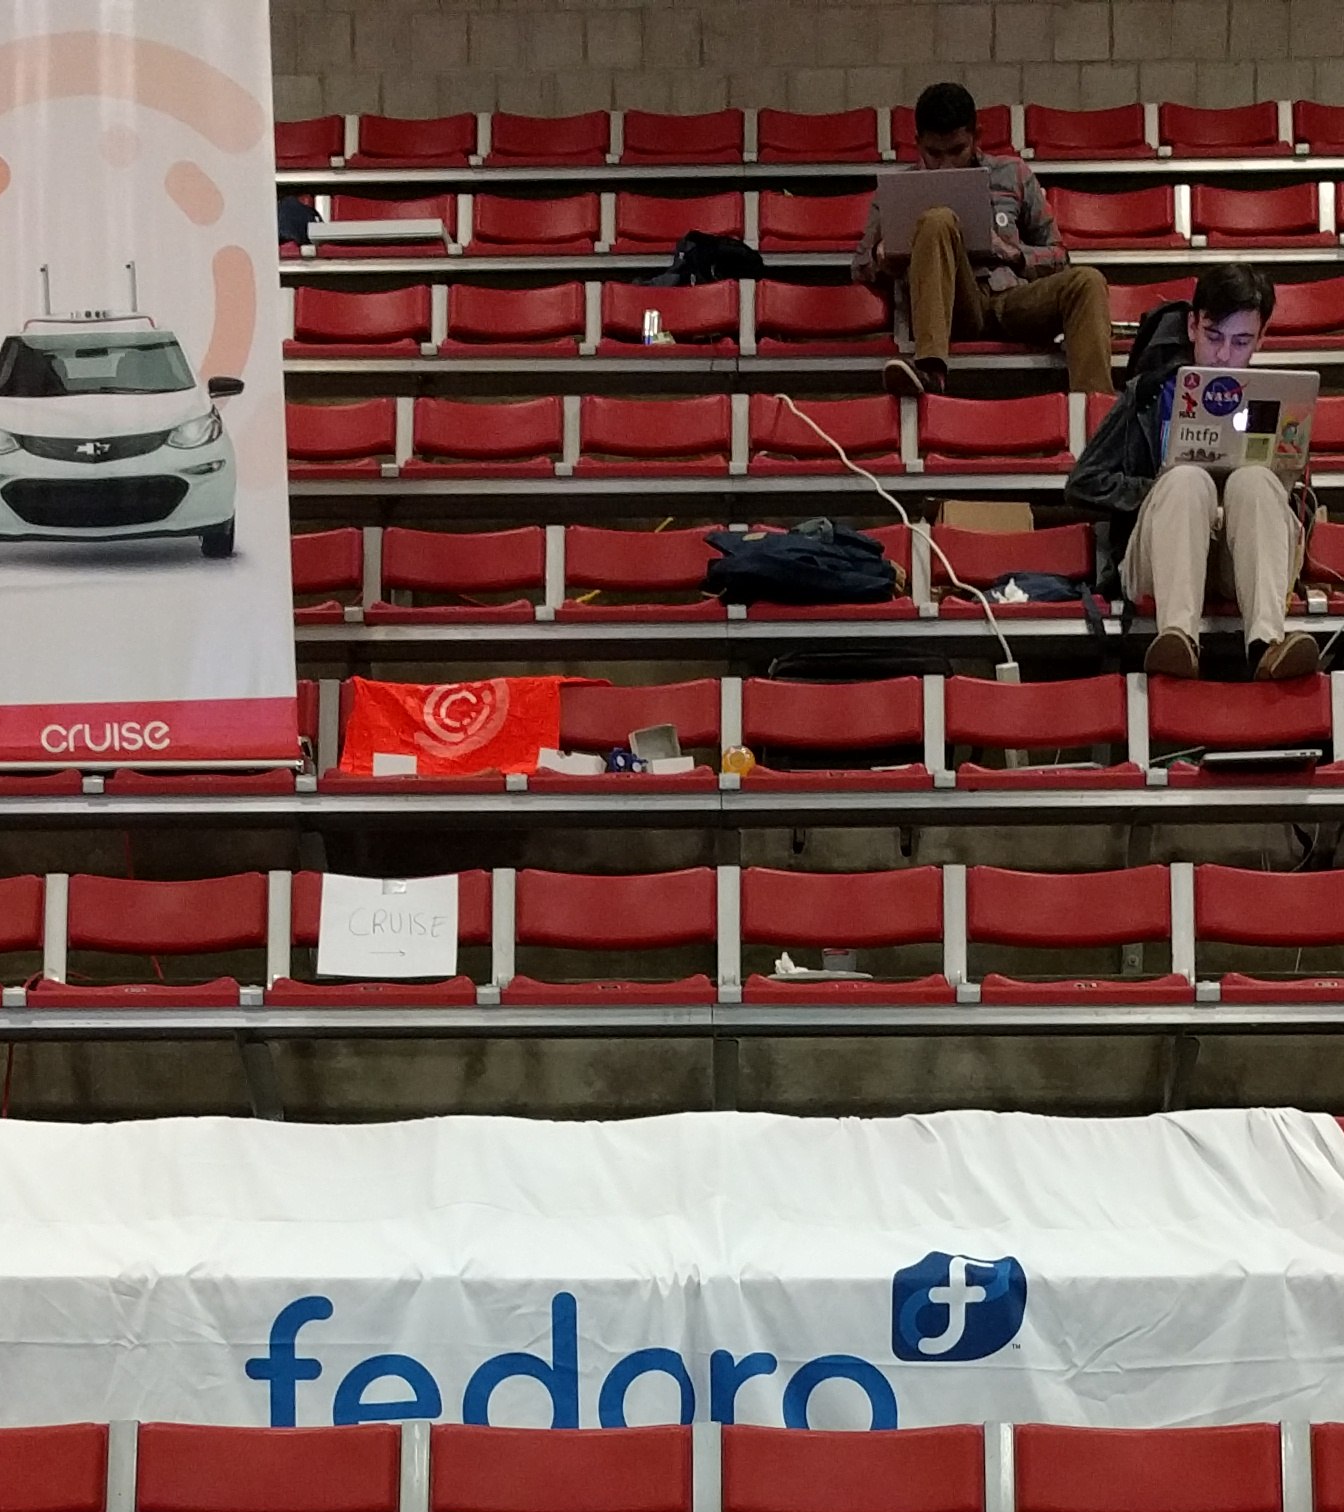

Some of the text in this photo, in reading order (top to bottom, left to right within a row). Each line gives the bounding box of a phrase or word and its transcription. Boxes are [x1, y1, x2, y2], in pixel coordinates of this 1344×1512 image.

[1206, 391, 1239, 402] NASA
[1180, 427, 1219, 445] ihtfp
[41, 720, 170, 753] cruise
[349, 908, 447, 937] CRUISE
